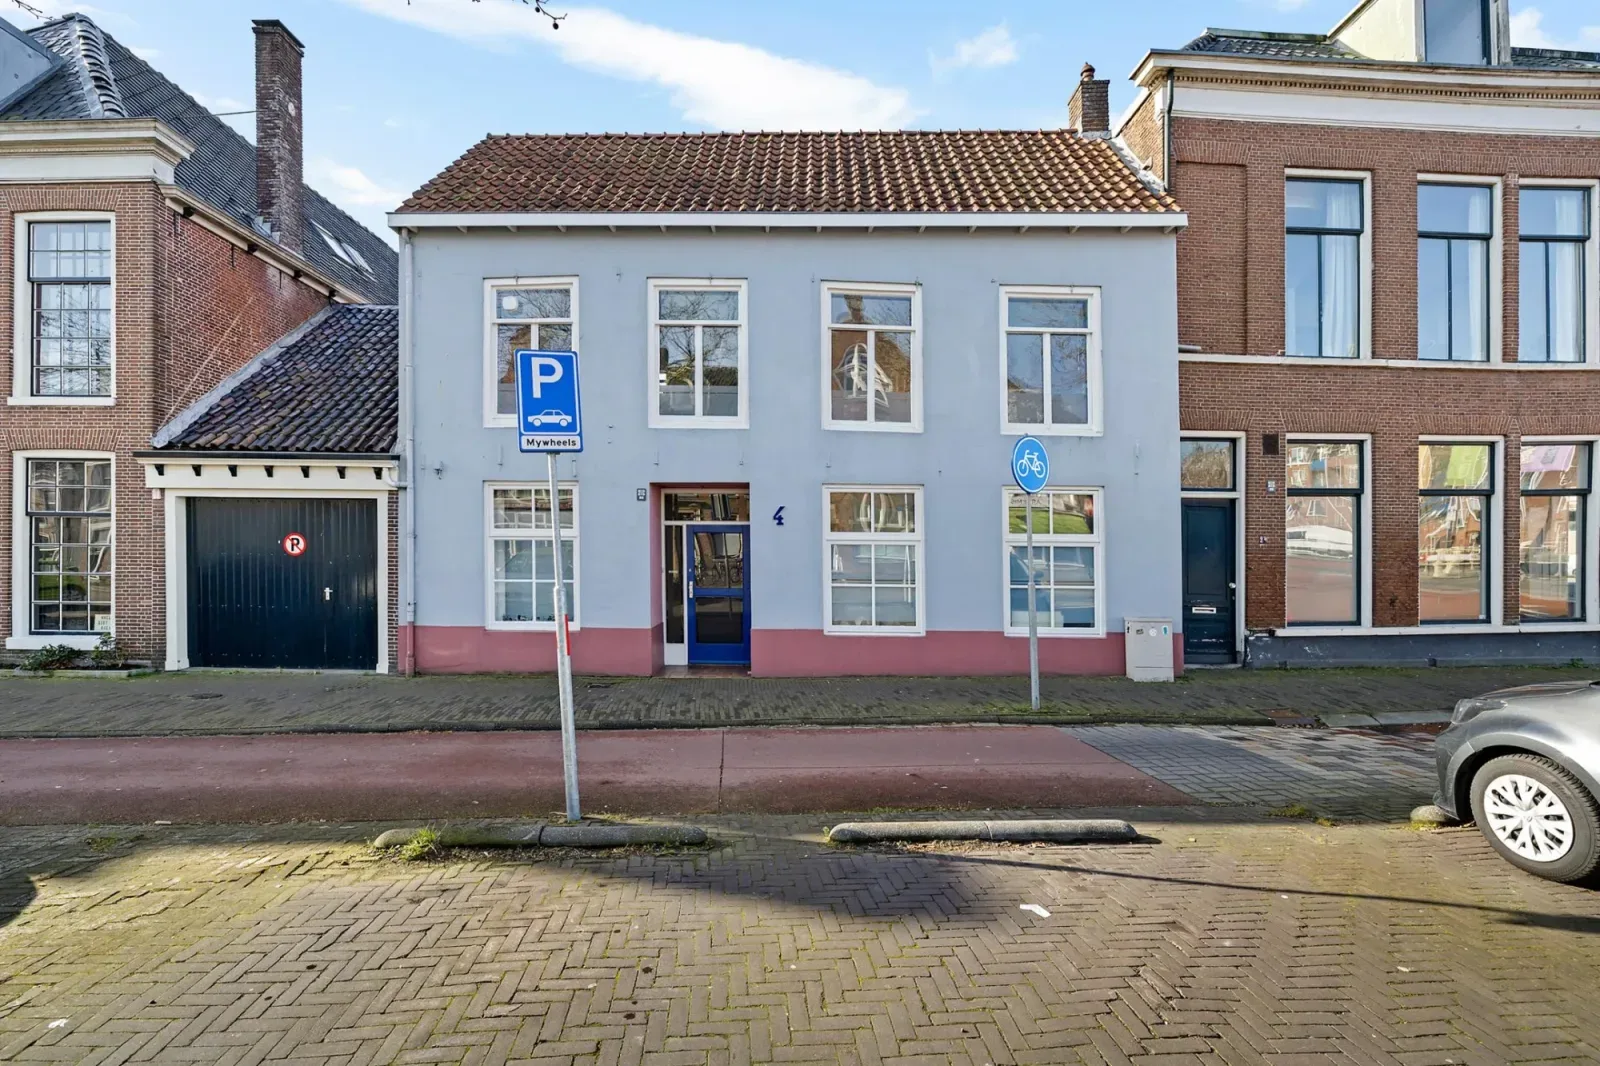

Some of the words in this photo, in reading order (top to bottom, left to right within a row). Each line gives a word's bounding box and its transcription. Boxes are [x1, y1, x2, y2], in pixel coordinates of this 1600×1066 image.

[531, 357, 563, 398] P
[526, 438, 577, 448] Mywheels
[773, 505, 786, 526] 4
[291, 537, 300, 551] P
